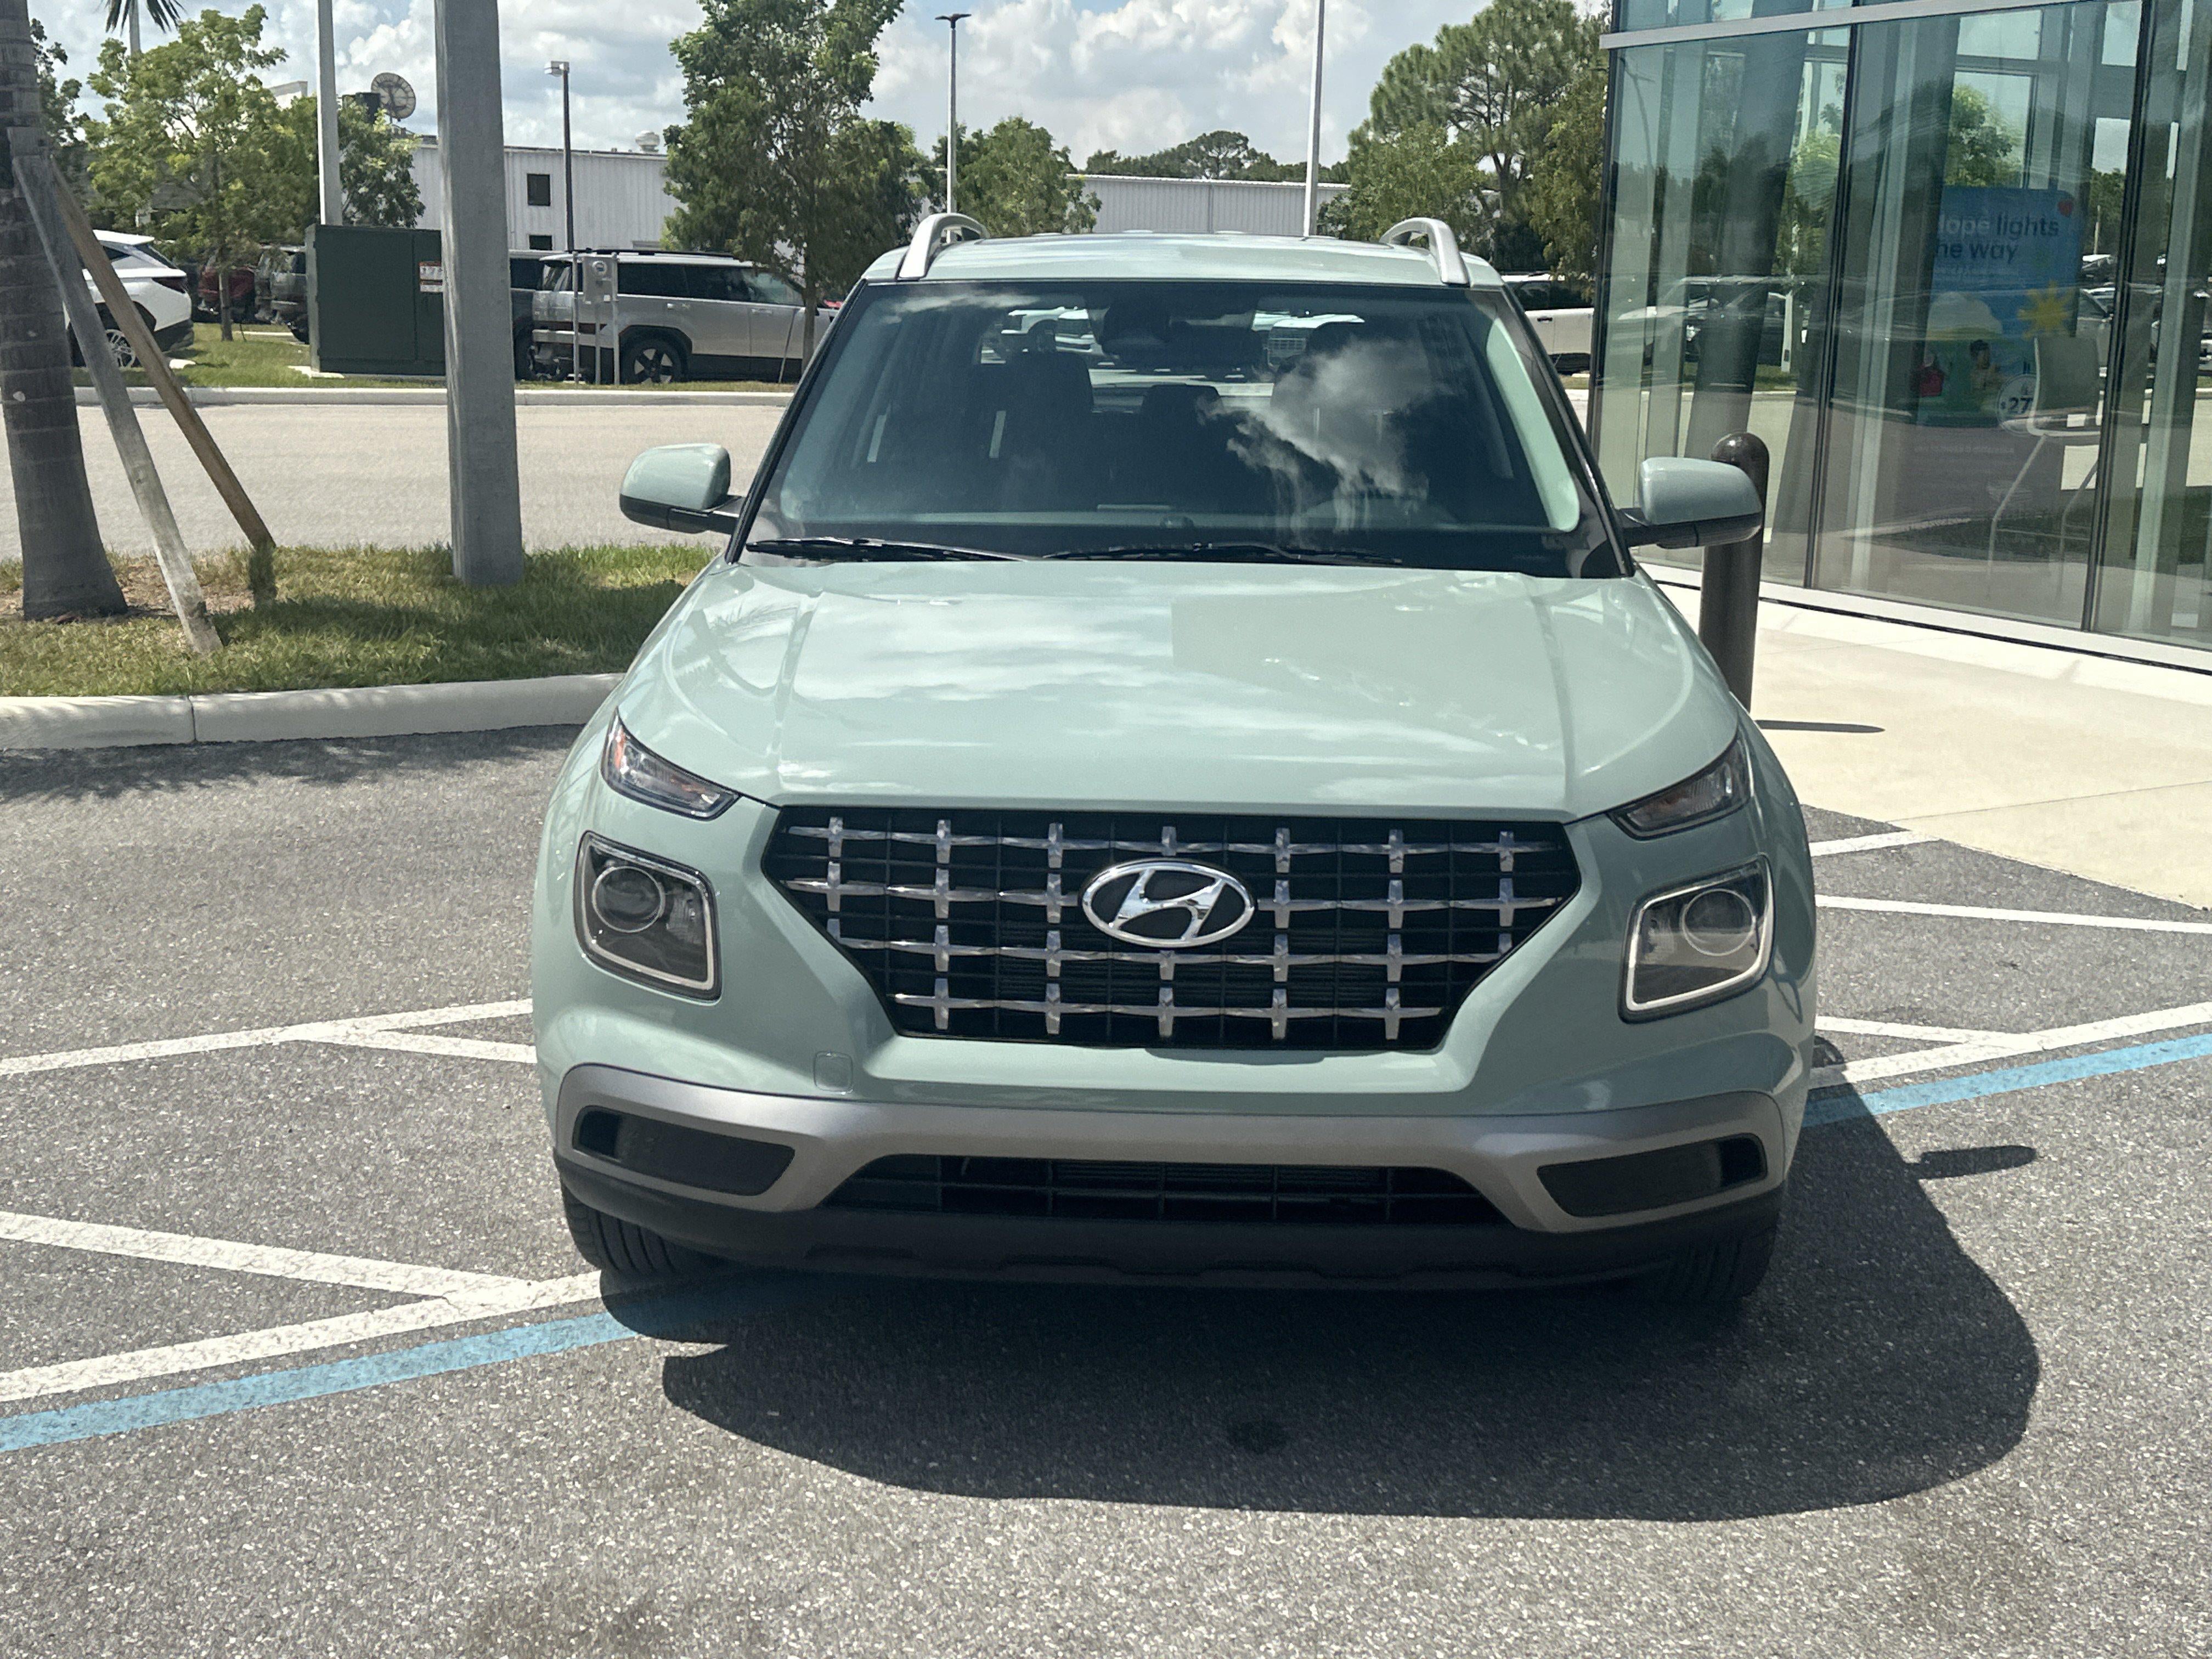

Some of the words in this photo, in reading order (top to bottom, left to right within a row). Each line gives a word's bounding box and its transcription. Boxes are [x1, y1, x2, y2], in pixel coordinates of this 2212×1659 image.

[1996, 212, 2059, 240] lights
[1936, 239, 1963, 259] he
[1969, 242, 2020, 265] way
